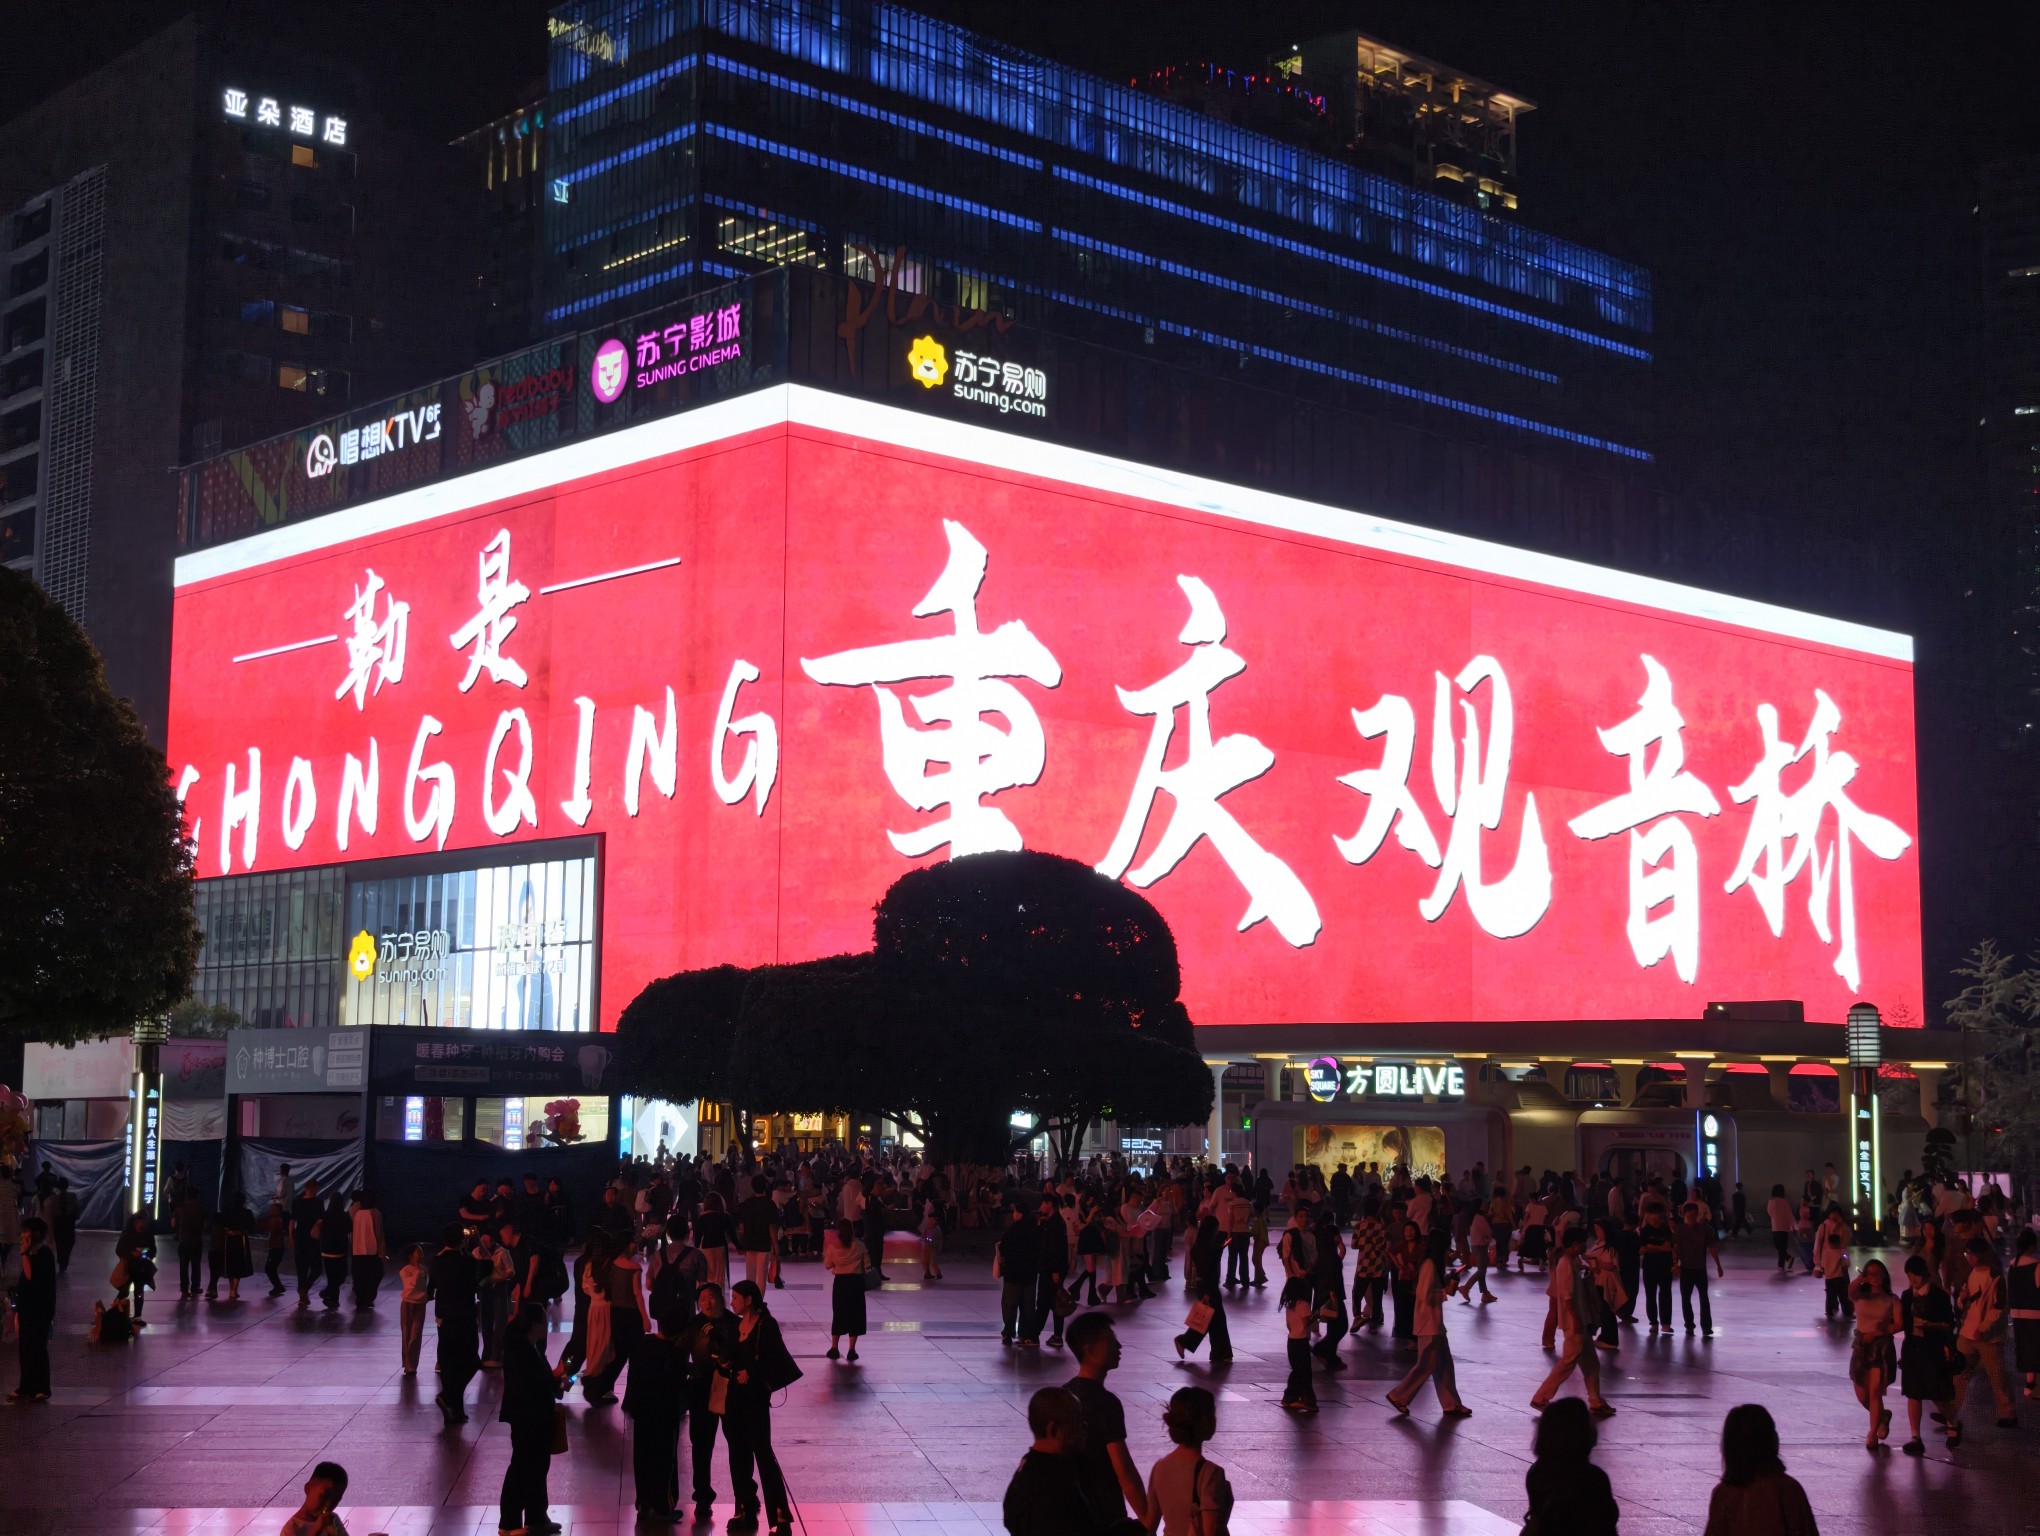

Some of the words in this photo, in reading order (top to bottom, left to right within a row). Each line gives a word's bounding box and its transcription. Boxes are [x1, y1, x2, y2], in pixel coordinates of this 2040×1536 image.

[225, 88, 347, 145] 亚朵酒店
[636, 303, 741, 368] 苏宁影城
[637, 360, 686, 388] SUNING
[689, 343, 741, 372] CINEMA
[955, 350, 1046, 400] 苏宁易购
[426, 403, 441, 423] 6F
[954, 383, 1046, 417] suning.com
[801, 519, 1912, 993] 重庆观音桥
[380, 929, 449, 963] 苏宁易购
[379, 967, 447, 987] suning.com
[1310, 1069, 1324, 1079] SKY
[1310, 1080, 1336, 1092] SQUARE
[1346, 1065, 1465, 1096] 方圆LIVE
[144, 1107, 157, 1204] 扣好人生第一粒扣子
